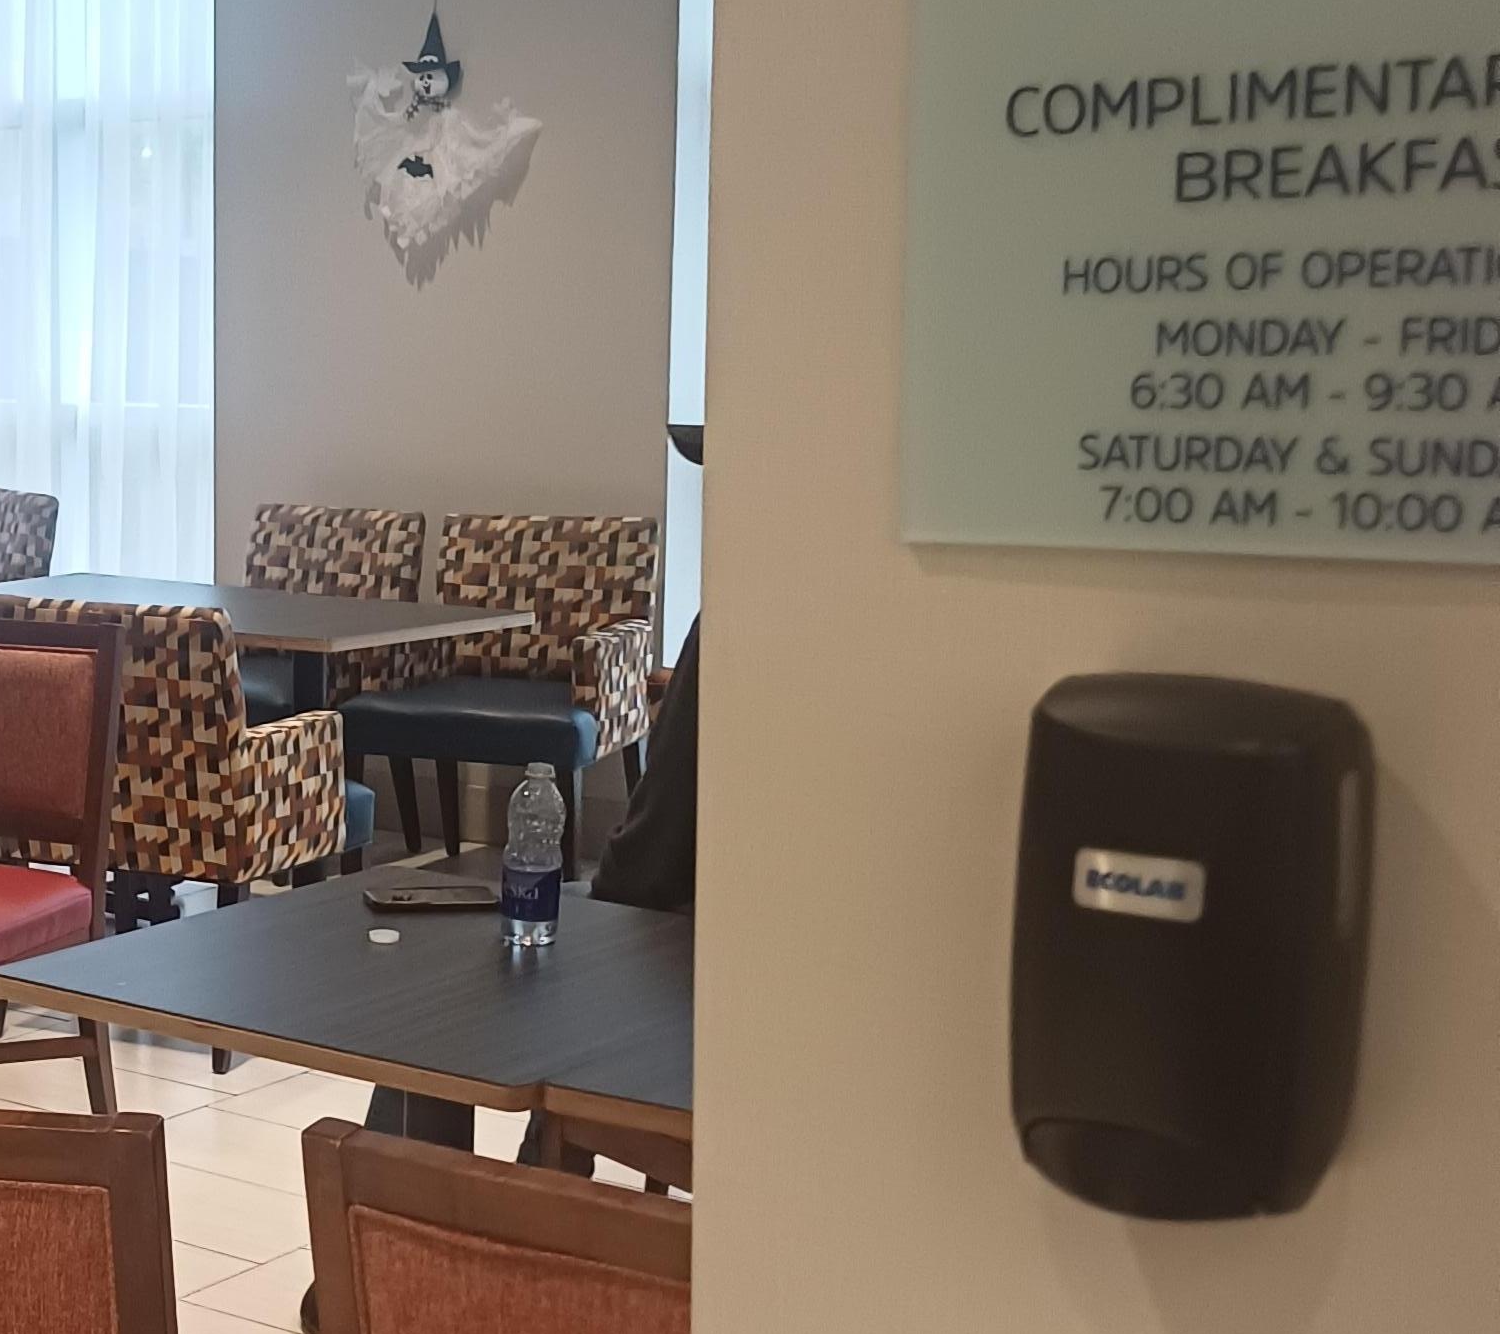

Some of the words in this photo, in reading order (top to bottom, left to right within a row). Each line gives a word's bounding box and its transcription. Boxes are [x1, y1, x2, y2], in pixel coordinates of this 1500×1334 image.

[1173, 135, 1500, 205] BREAKFA
[1062, 252, 1208, 296] HOURS
[1225, 250, 1284, 292] OF
[1300, 243, 1500, 292] OPERATI
[1155, 318, 1346, 357] MONDAY
[1129, 370, 1225, 411] 6:30
[1241, 372, 1311, 411] AM
[1363, 370, 1468, 413] 9:30
[1078, 431, 1299, 475] SATURDAY
[1315, 435, 1350, 477] &
[1368, 436, 1500, 479] SUND
[1099, 483, 1195, 526] 7:00
[1209, 487, 1279, 528] AM
[1330, 489, 1465, 536] 10:00
